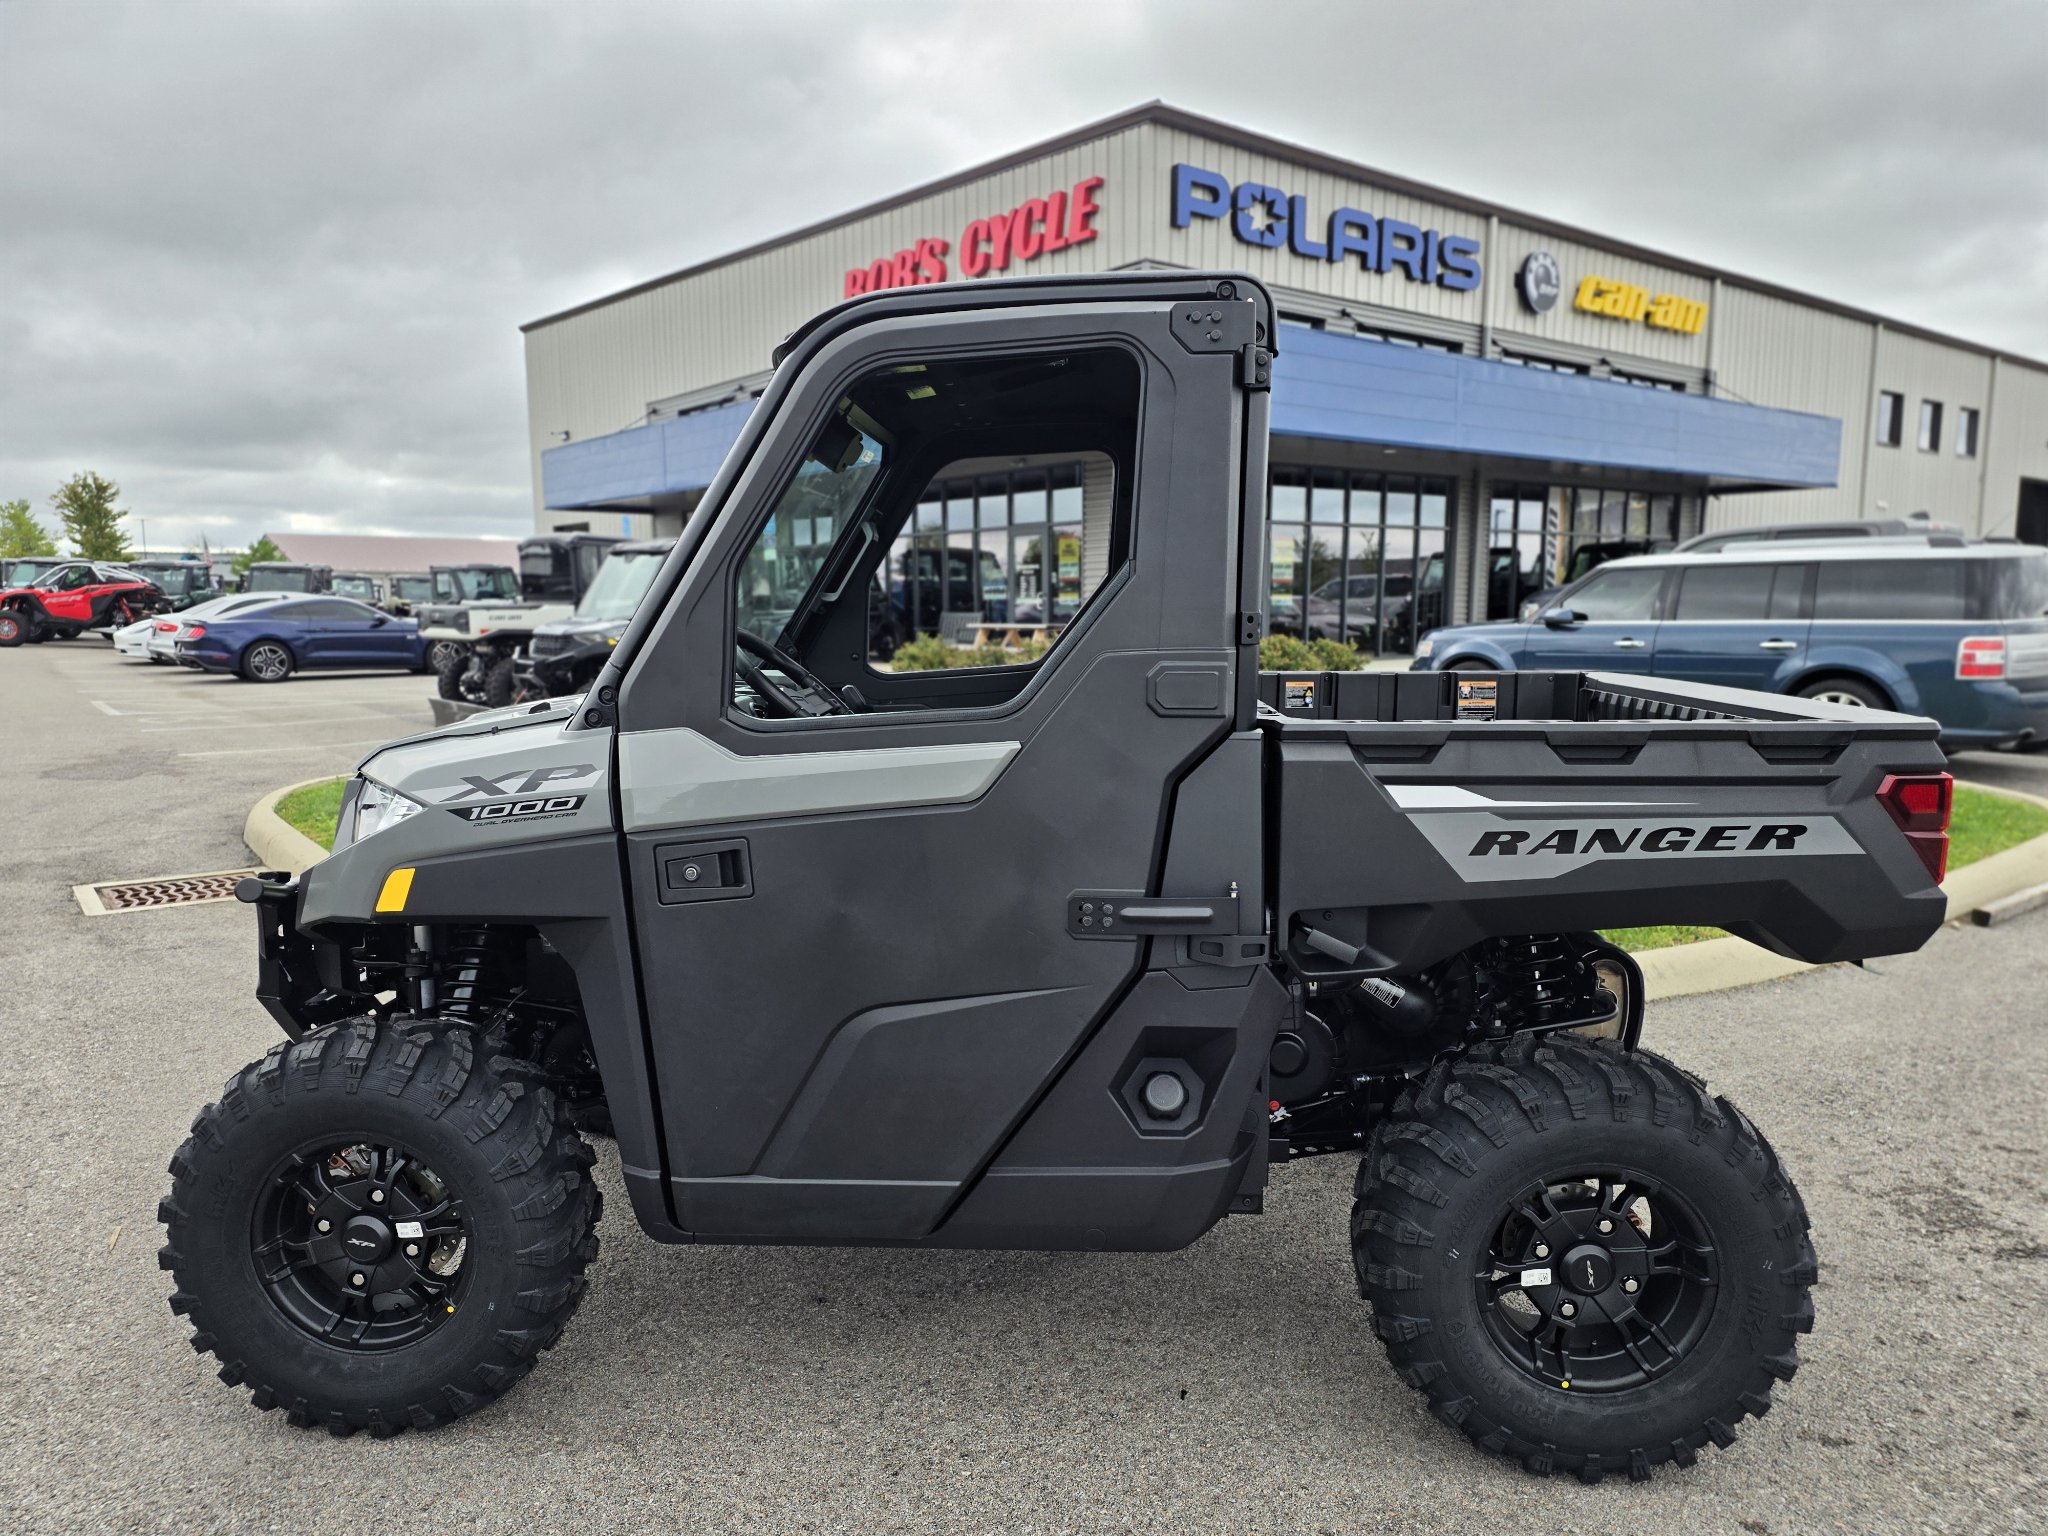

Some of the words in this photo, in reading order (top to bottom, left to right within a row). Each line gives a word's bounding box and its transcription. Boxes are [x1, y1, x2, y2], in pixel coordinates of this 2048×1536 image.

[844, 238, 949, 299] BOB'S
[960, 176, 1105, 278] CYCLE
[1172, 162, 1482, 291] POLARIS
[440, 764, 598, 802] XP
[469, 797, 578, 820] 1000
[501, 814, 553, 824] OVERHEAD
[1468, 824, 1808, 857] RANGER
